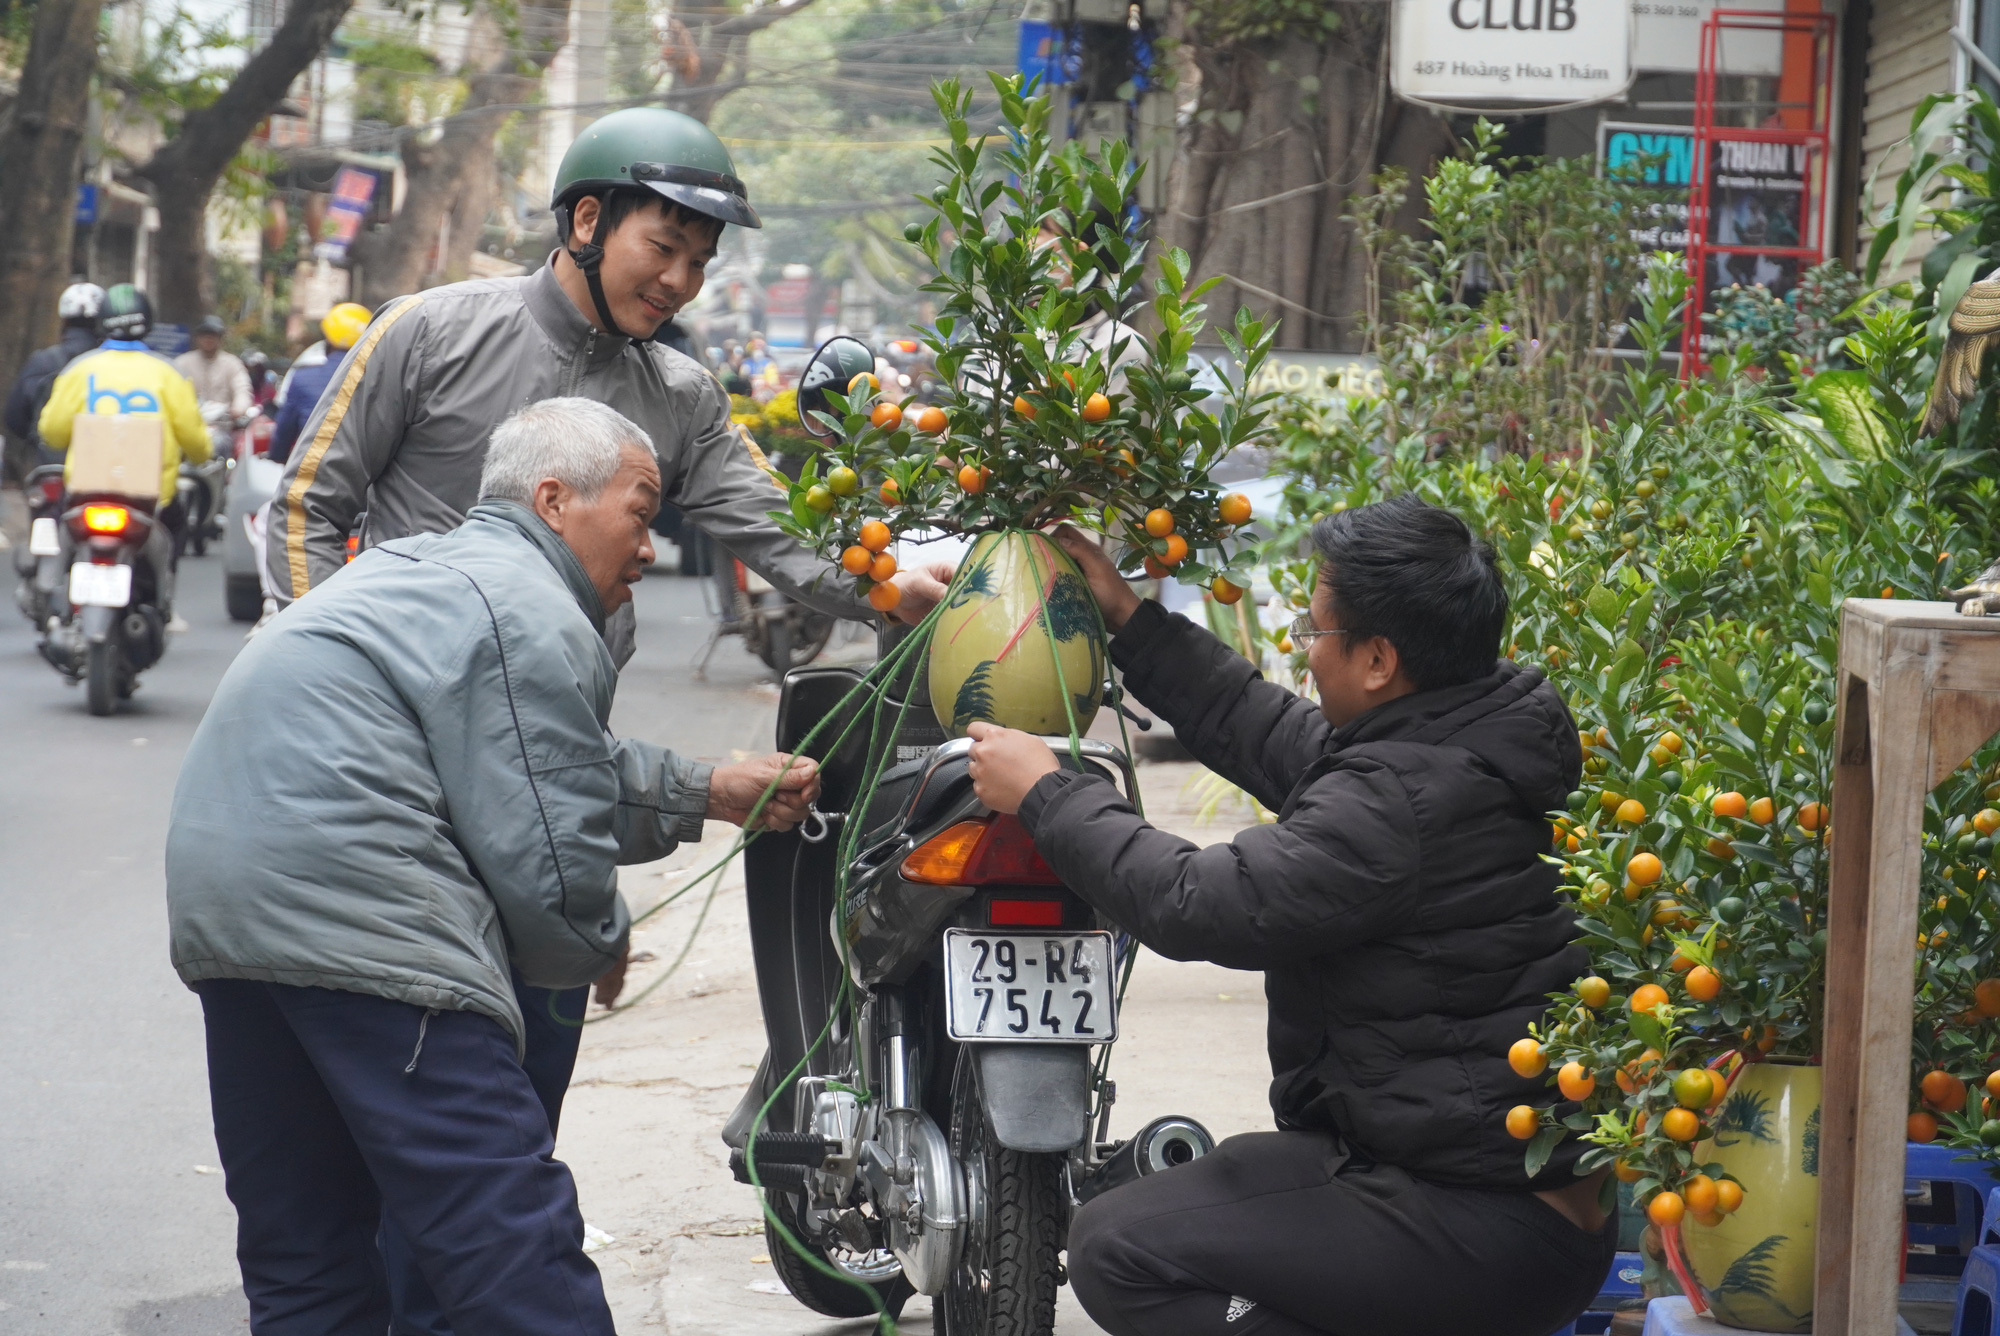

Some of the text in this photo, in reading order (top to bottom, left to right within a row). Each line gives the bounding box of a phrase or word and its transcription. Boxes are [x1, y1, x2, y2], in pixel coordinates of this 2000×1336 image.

[1451, 0, 1577, 31] CLUB
[1413, 60, 1609, 81] 487 Hoàng Hoa Thám
[1608, 132, 1704, 184] GYM
[88, 373, 159, 414] be
[969, 939, 1091, 984] 29-R4
[973, 987, 1095, 1034] 7542
